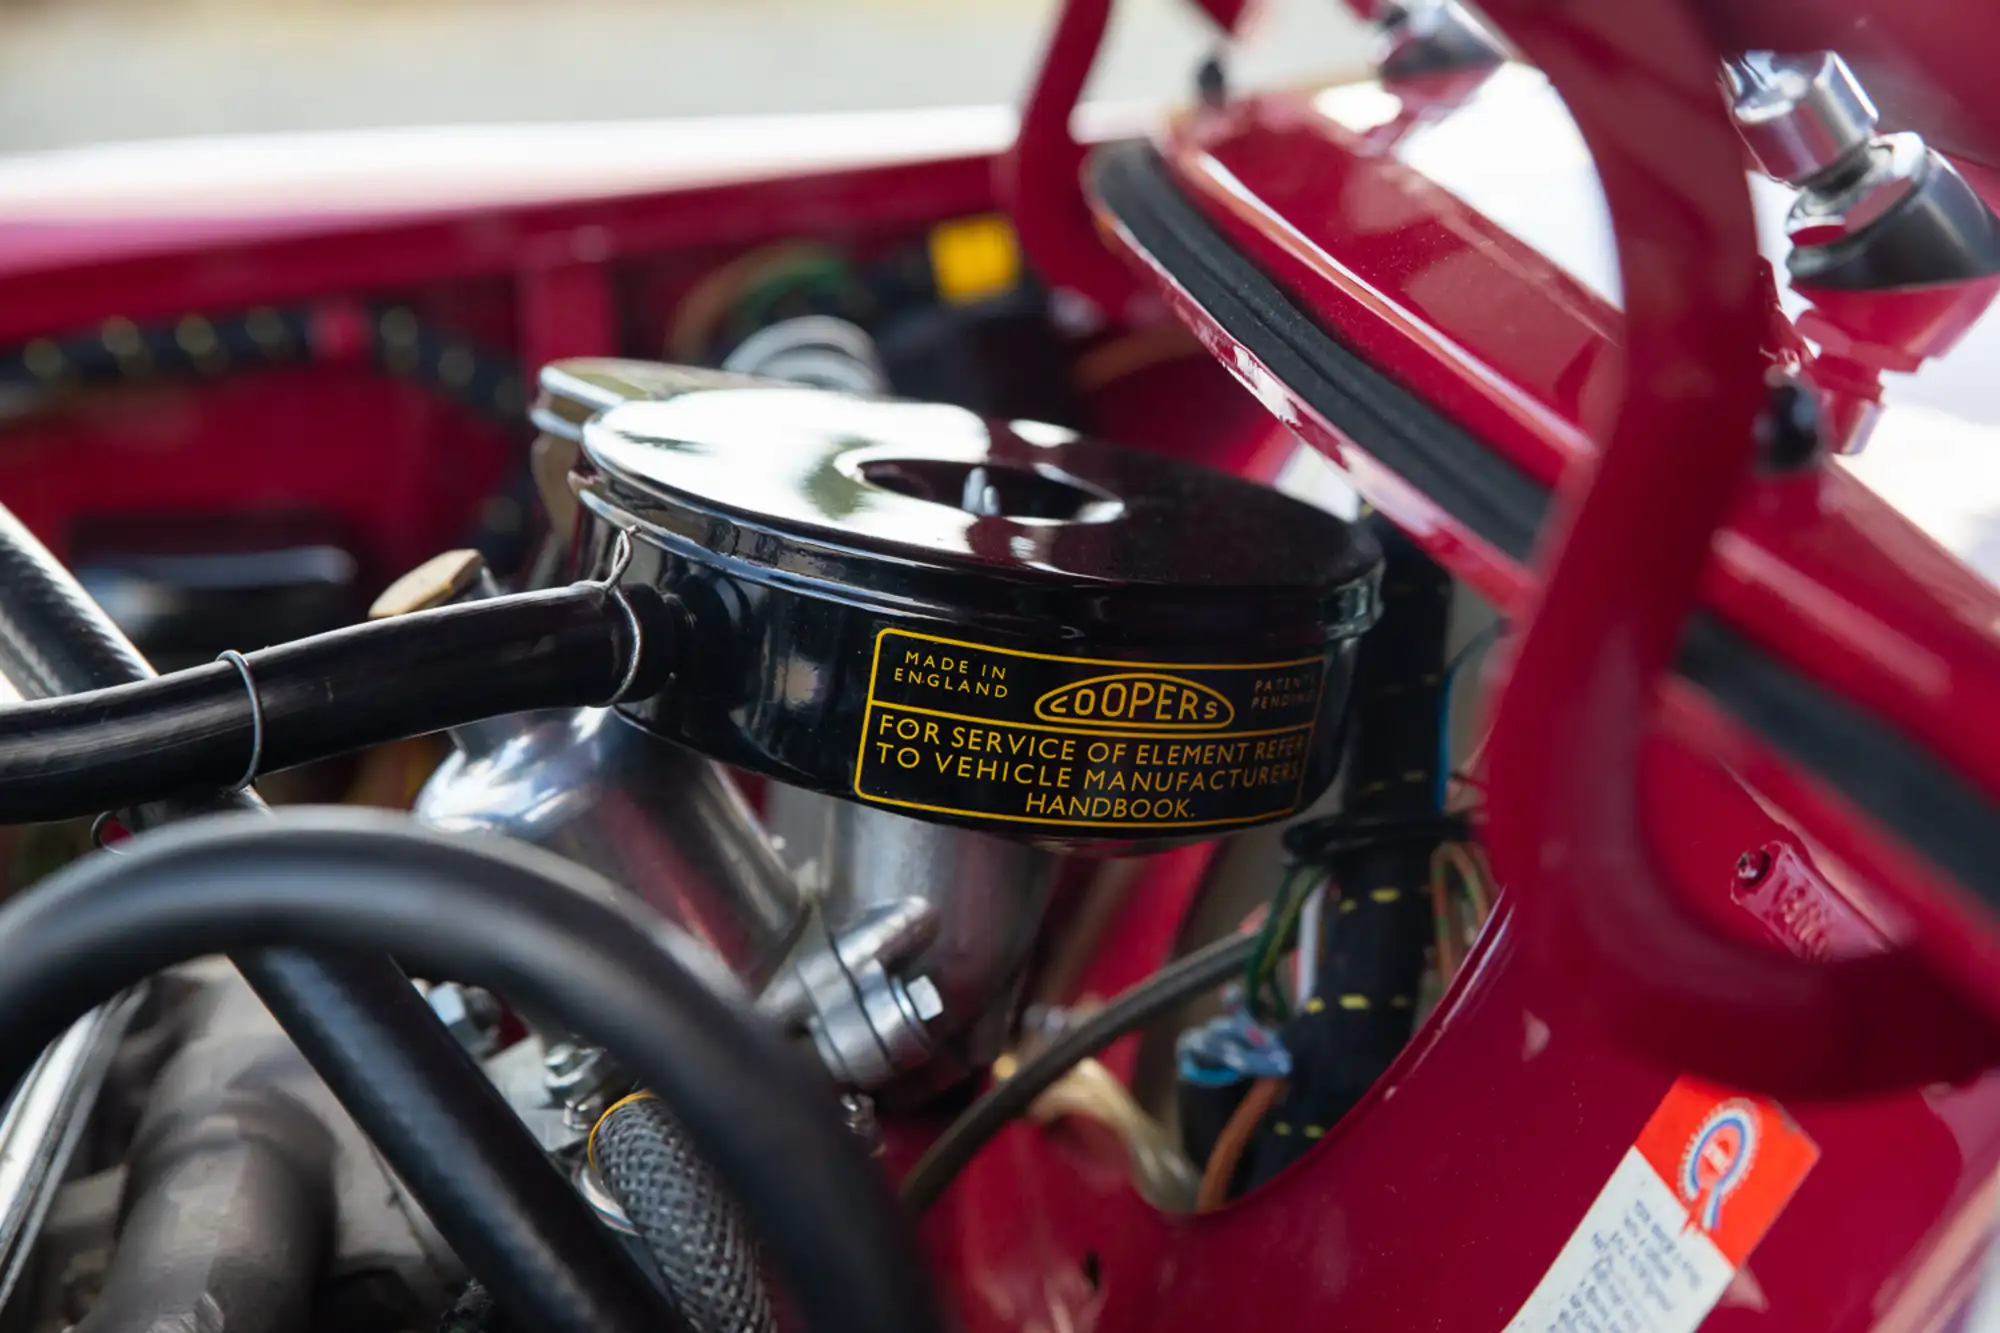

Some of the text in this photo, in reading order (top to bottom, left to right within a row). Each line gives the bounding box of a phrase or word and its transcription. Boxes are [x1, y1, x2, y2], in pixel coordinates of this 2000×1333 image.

[905, 650, 1006, 680] MADE IN
[894, 667, 1008, 698] ENGLAND
[879, 713, 940, 745] FOR
[951, 726, 1076, 760] SERVICE
[1087, 742, 1127, 763] OF
[1136, 743, 1250, 765] ELEMENT
[876, 742, 1299, 792] TO VEHICLE MANUFACTURERS
[1025, 792, 1196, 818] HANDBOOK.
